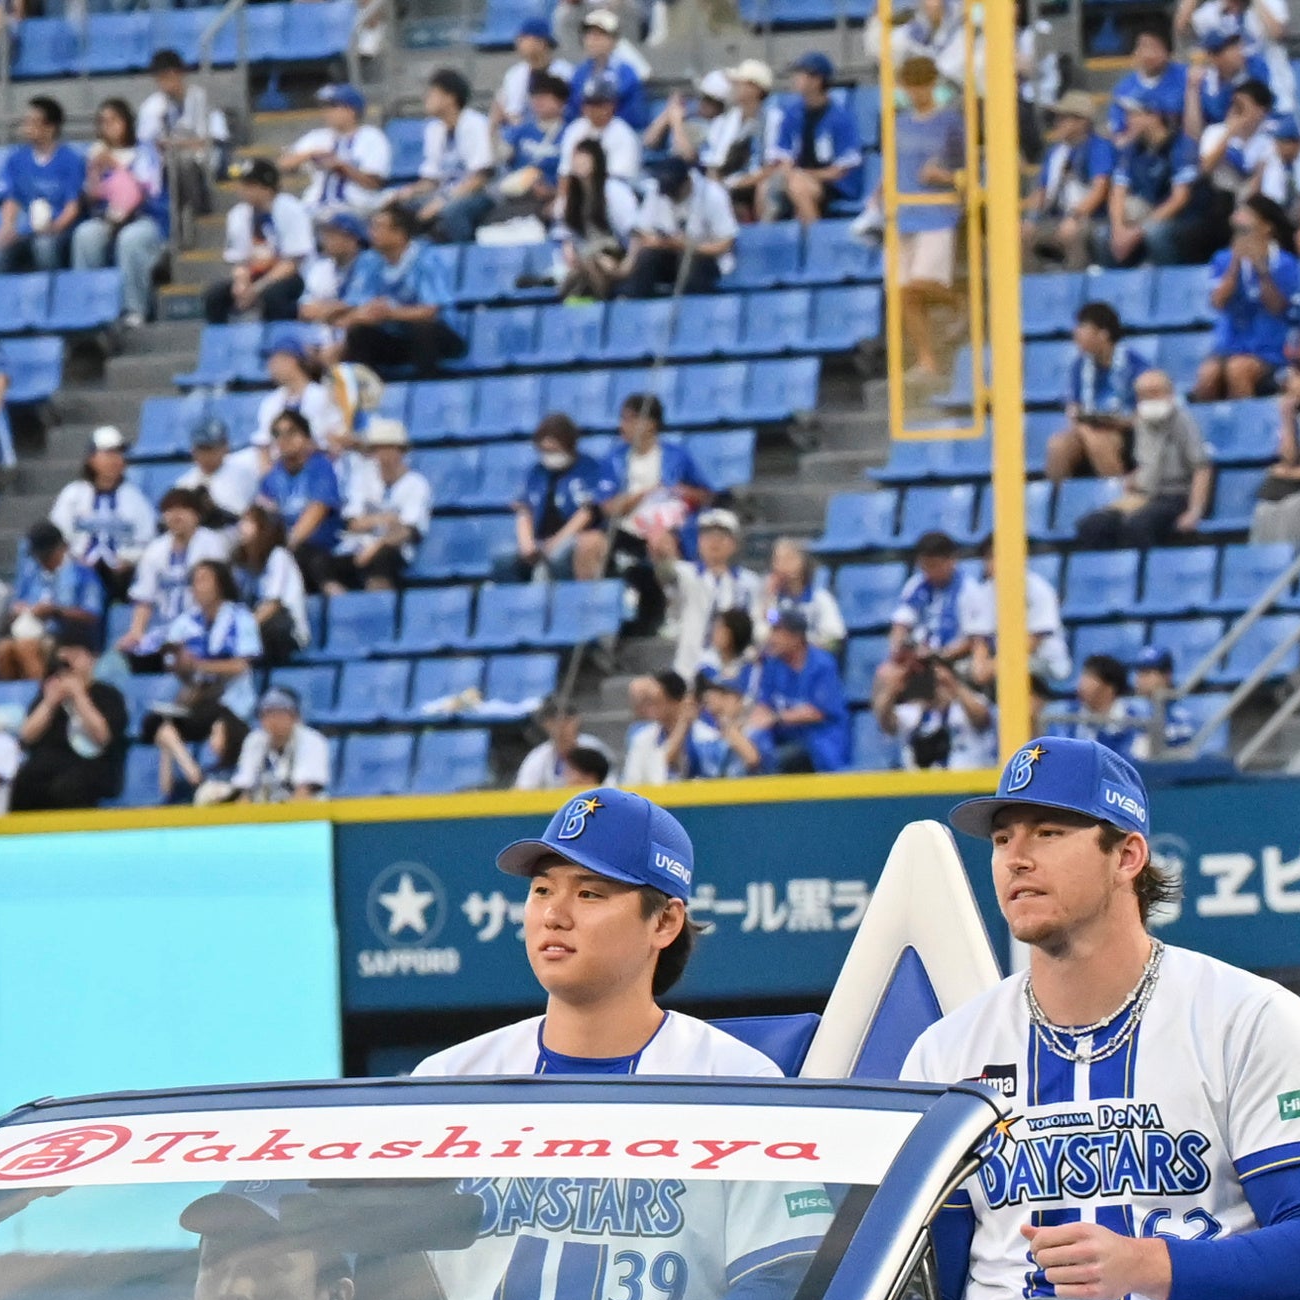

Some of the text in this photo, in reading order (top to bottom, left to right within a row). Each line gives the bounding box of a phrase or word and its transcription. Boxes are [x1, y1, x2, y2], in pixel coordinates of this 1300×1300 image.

[1105, 788, 1146, 823] UYENO
[655, 852, 692, 885] UYENO
[358, 948, 460, 977] SAPPORO
[1027, 1103, 1164, 1132] YOKOHAMA DeNA
[132, 1126, 820, 1170] Takashimaya
[977, 1128, 1212, 1211] BAYSTARS
[790, 1197, 832, 1211] Hise
